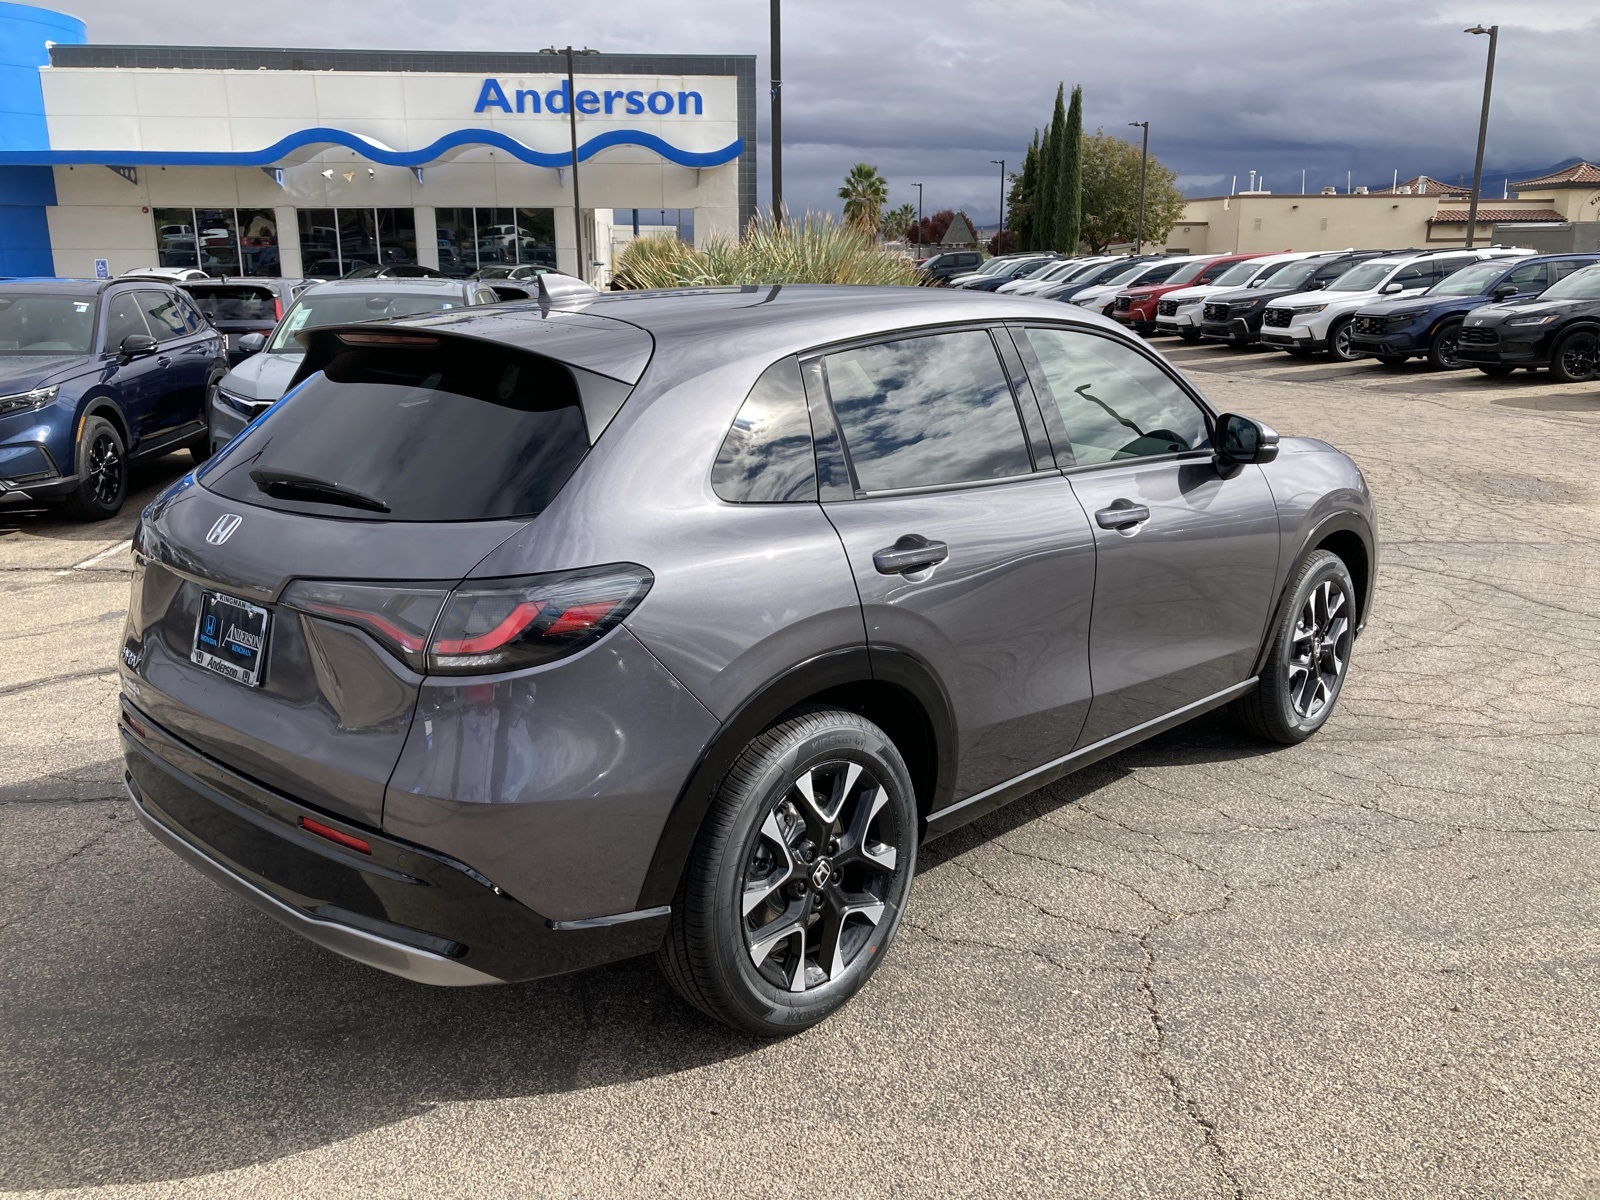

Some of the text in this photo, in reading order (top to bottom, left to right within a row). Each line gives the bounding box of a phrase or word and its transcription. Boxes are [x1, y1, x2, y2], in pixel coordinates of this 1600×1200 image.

[473, 78, 704, 116] Anderson
[219, 595, 247, 609] KINGMAN
[200, 633, 218, 647] HONDA
[222, 623, 261, 648] ANDERSON
[207, 656, 238, 678] Anderson
